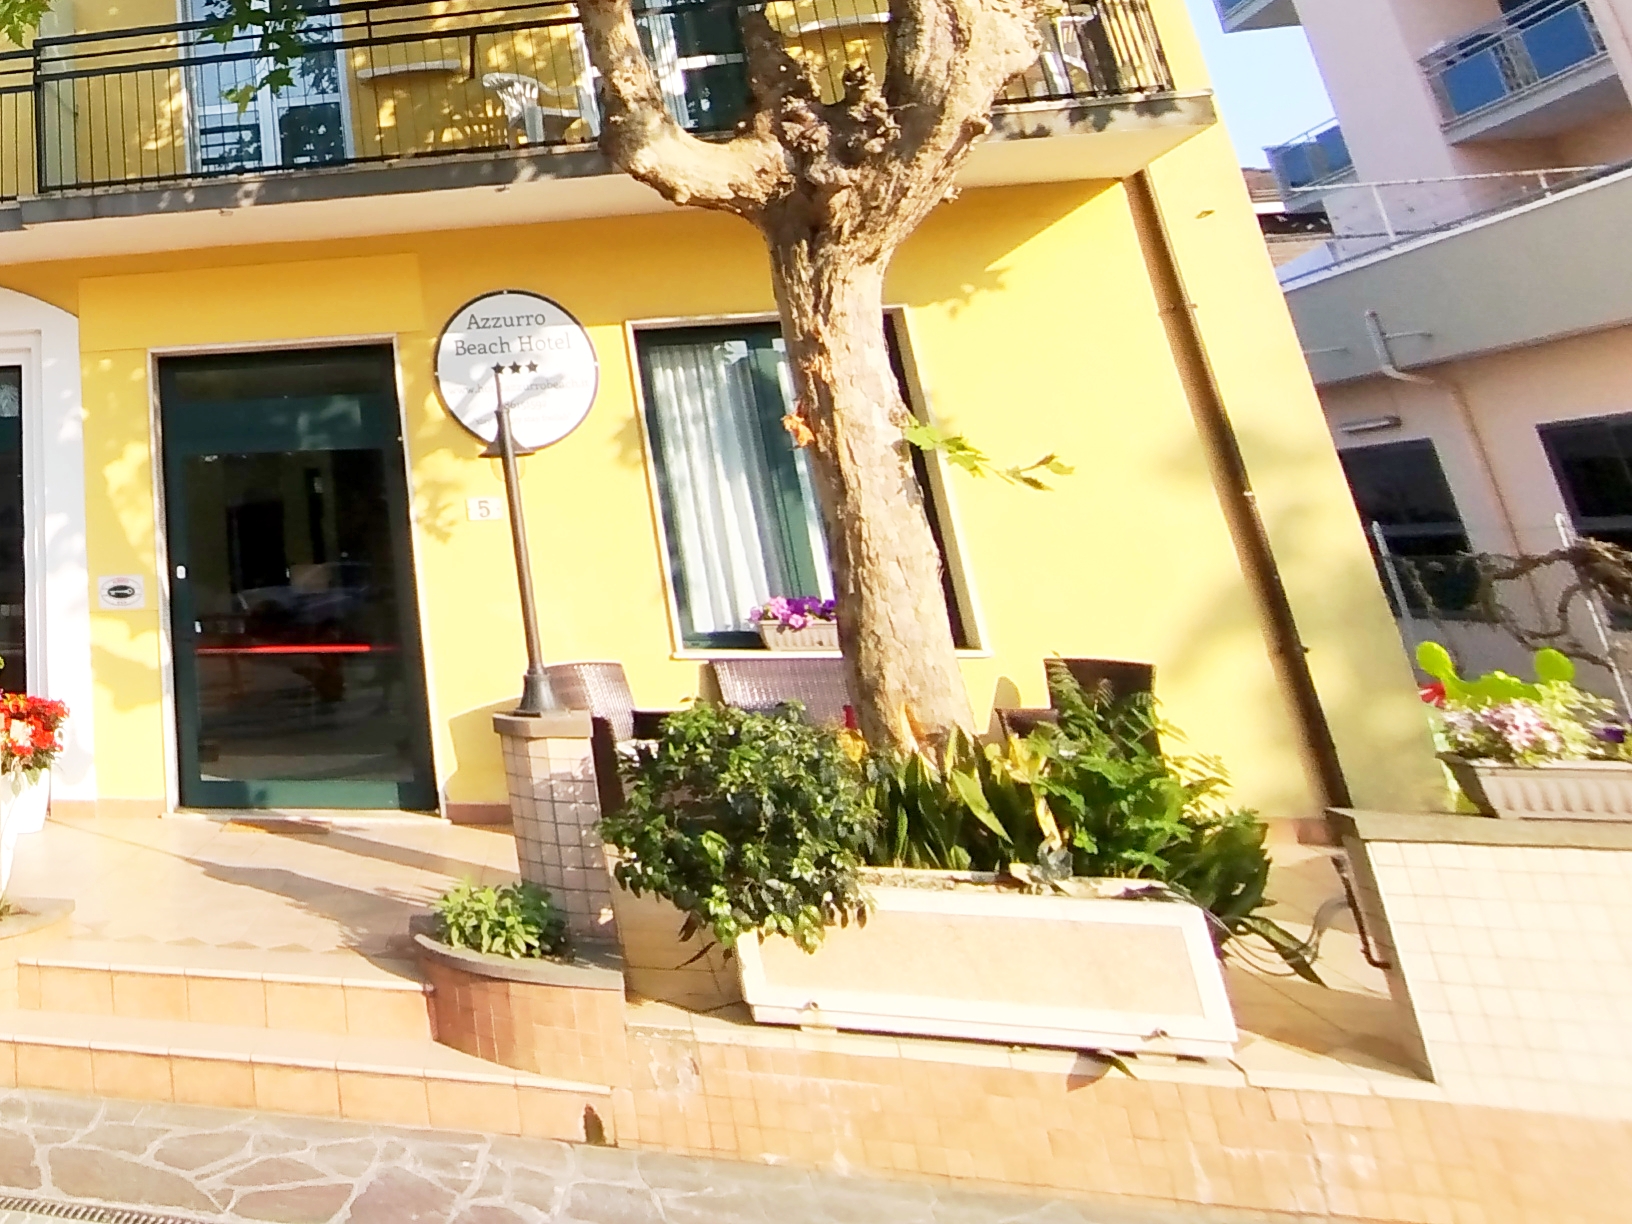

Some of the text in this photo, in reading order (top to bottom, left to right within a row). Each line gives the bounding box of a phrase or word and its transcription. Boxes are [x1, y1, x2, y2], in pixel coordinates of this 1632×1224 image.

[467, 313, 546, 330] Azzurro
[454, 332, 572, 356] Beach Hotel
[448, 379, 590, 393] www.hotazzurrobeach.it
[478, 500, 491, 518] 5
